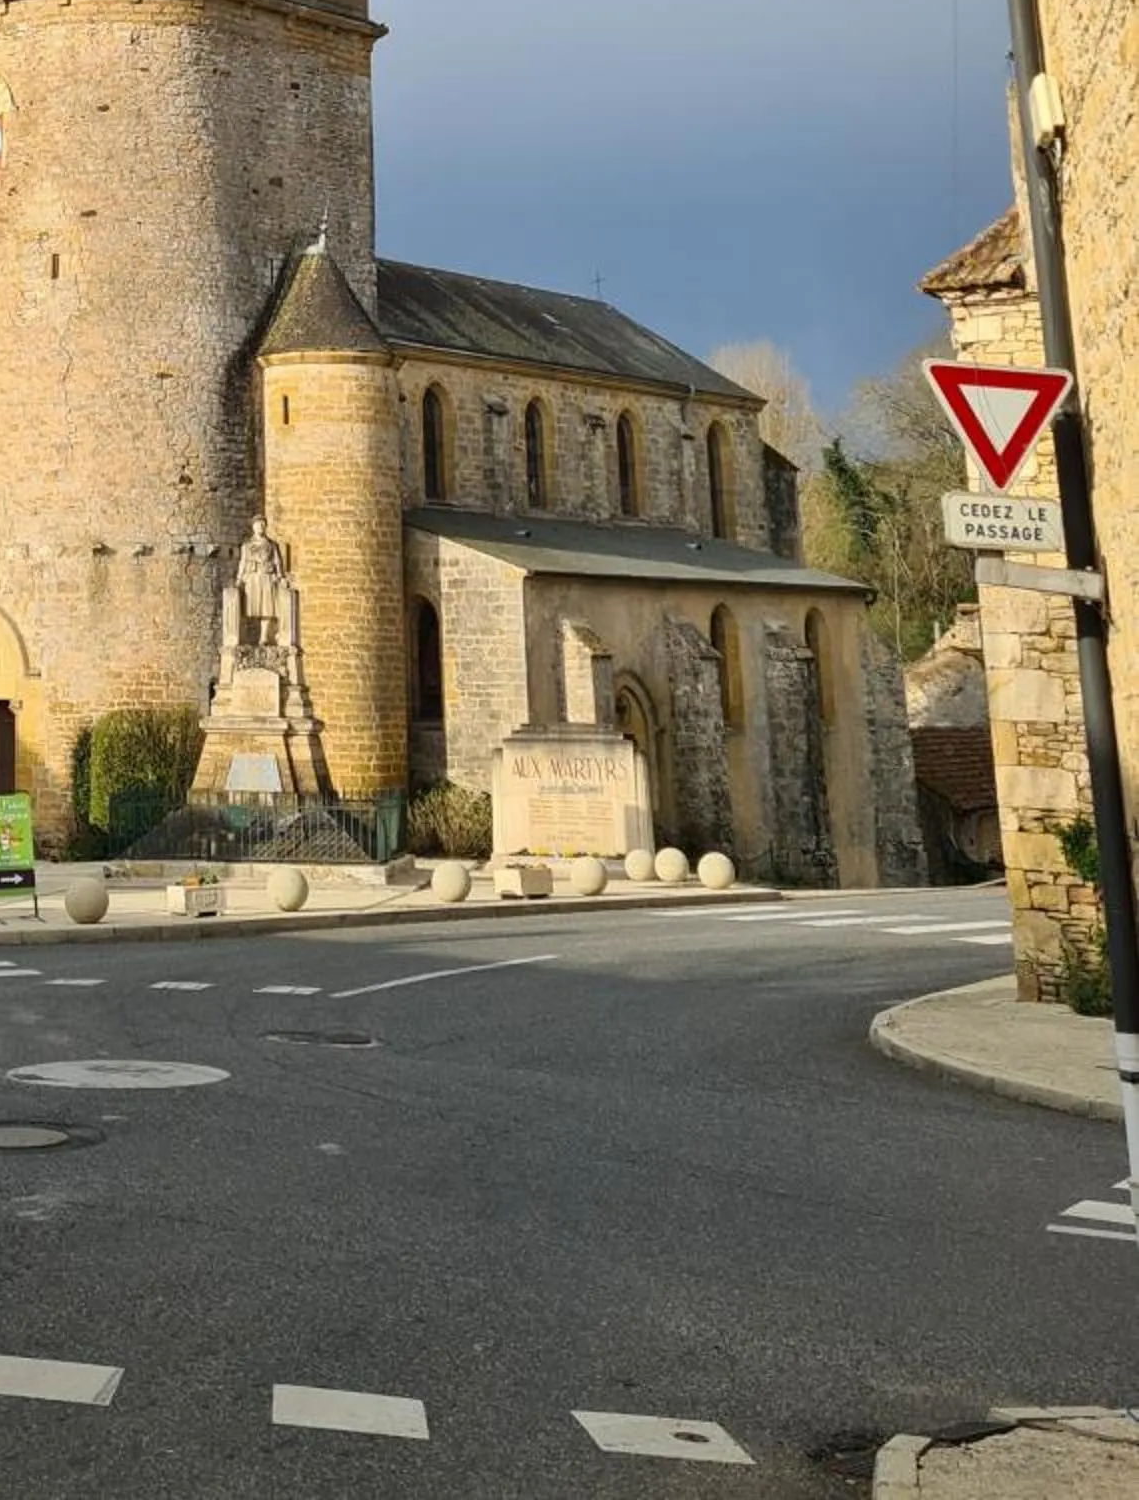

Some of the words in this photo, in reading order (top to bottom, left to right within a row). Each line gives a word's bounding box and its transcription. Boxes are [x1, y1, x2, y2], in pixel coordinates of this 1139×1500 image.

[959, 503, 1013, 520] CEDEZ
[1027, 507, 1048, 522] LE
[964, 523, 1043, 541] PASSAGE
[512, 755, 542, 780] AUX
[548, 756, 629, 782] MARTYRS
